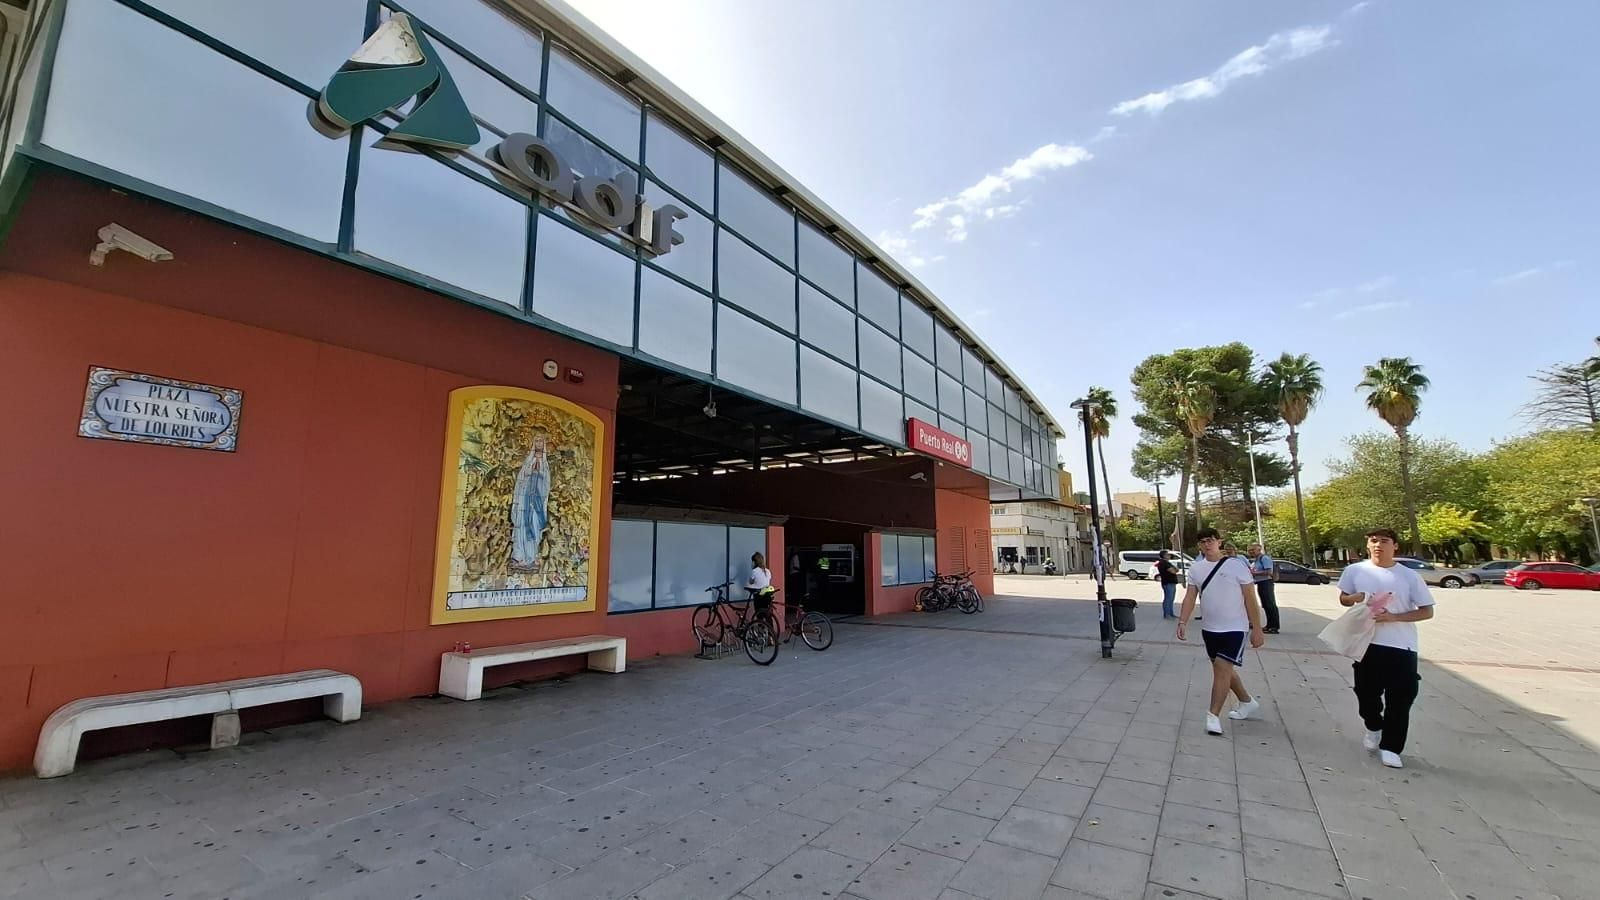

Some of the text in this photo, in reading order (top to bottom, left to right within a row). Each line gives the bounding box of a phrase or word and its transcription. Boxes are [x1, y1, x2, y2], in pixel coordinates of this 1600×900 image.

[148, 384, 191, 403] PLAZA
[102, 397, 226, 426] NUESTRA SEÑORA
[120, 417, 207, 440] DE LOURDES
[919, 428, 955, 456] Puerto Real
